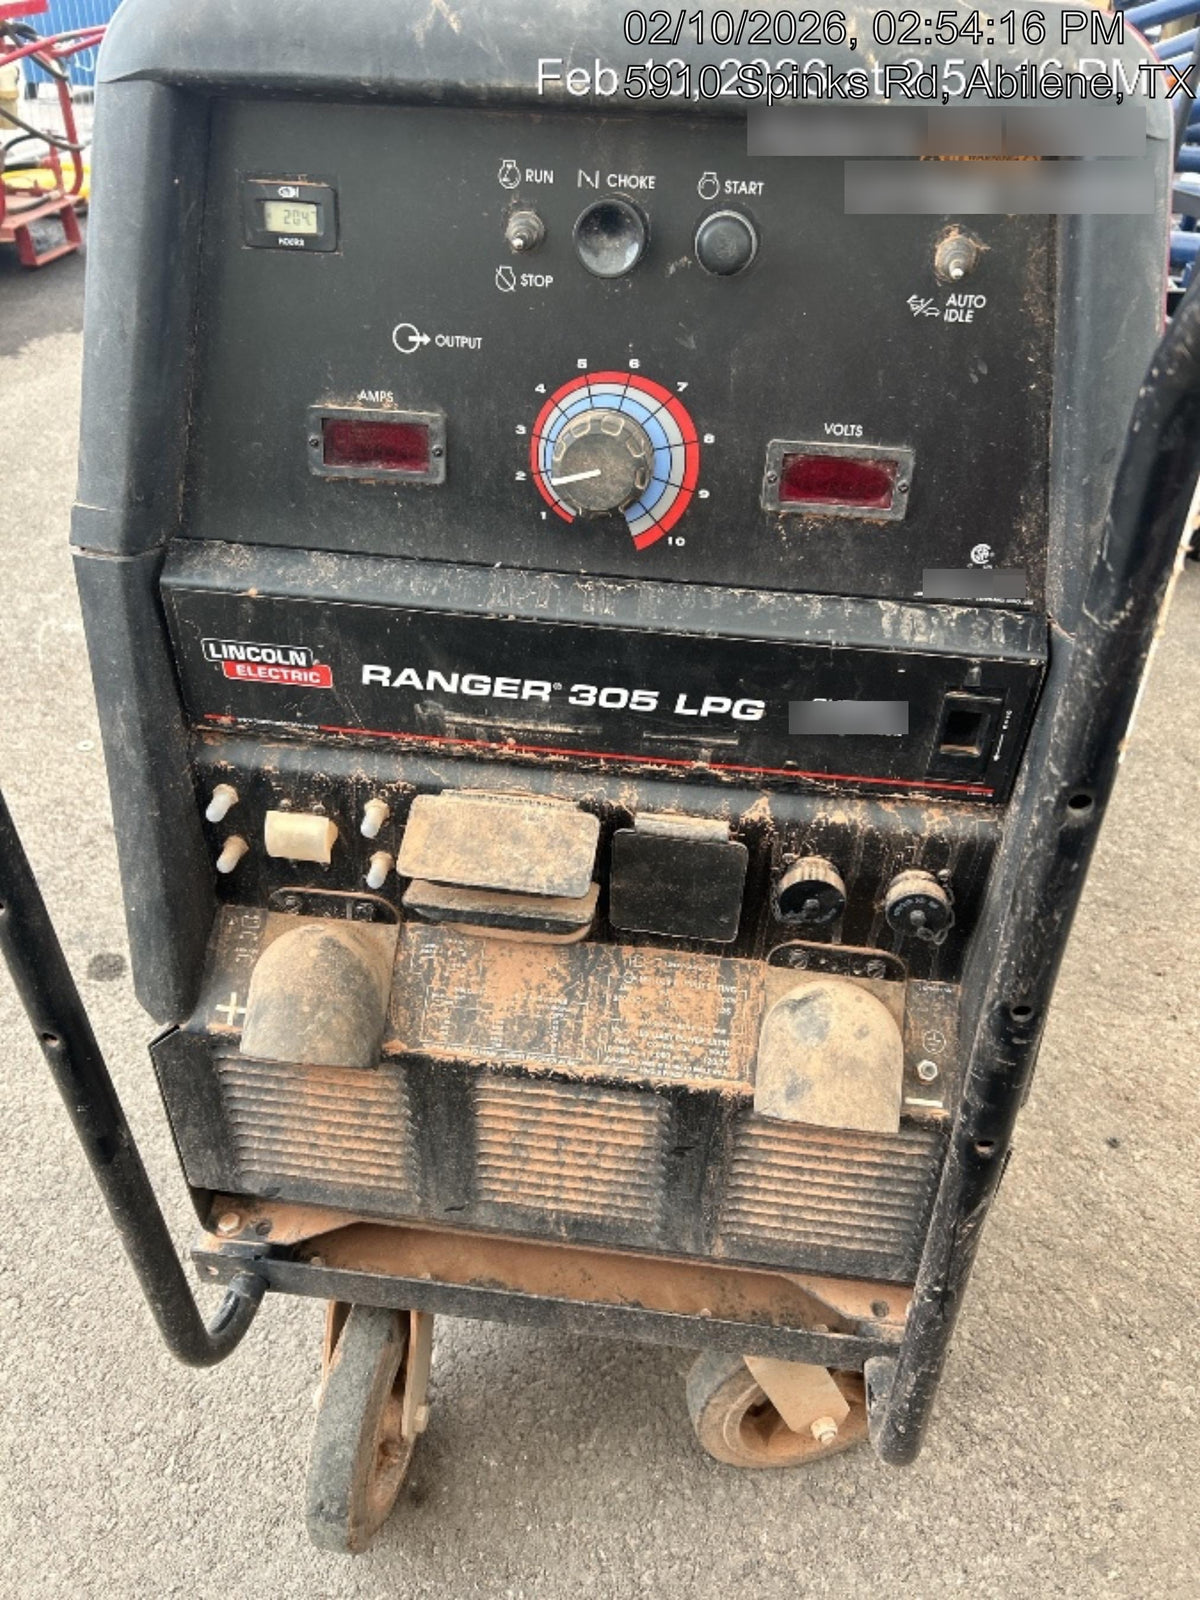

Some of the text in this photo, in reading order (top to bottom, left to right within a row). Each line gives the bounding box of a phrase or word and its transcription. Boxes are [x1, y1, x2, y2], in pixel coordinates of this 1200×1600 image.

[525, 168, 554, 184] RUN
[606, 173, 656, 190] CHOKE
[724, 180, 765, 196] START
[520, 273, 554, 288] STOP
[945, 292, 987, 309] AUTO
[943, 308, 975, 322] IDLE
[434, 333, 482, 349] OUTPUT
[577, 358, 588, 369] 5
[629, 358, 640, 369] 6
[534, 383, 546, 394] 4
[676, 381, 689, 392] 7
[357, 389, 394, 402] AMPS
[515, 424, 527, 435] 3
[824, 422, 863, 437] VOLTS
[703, 433, 715, 444] 8
[514, 470, 527, 481] 2
[698, 489, 710, 499] 9
[540, 511, 547, 520] 1
[667, 536, 686, 547] 10
[208, 642, 308, 666] LINCOLN
[235, 663, 321, 684] ELECTRIC
[568, 684, 661, 712] 305
[674, 693, 767, 721] LPG
